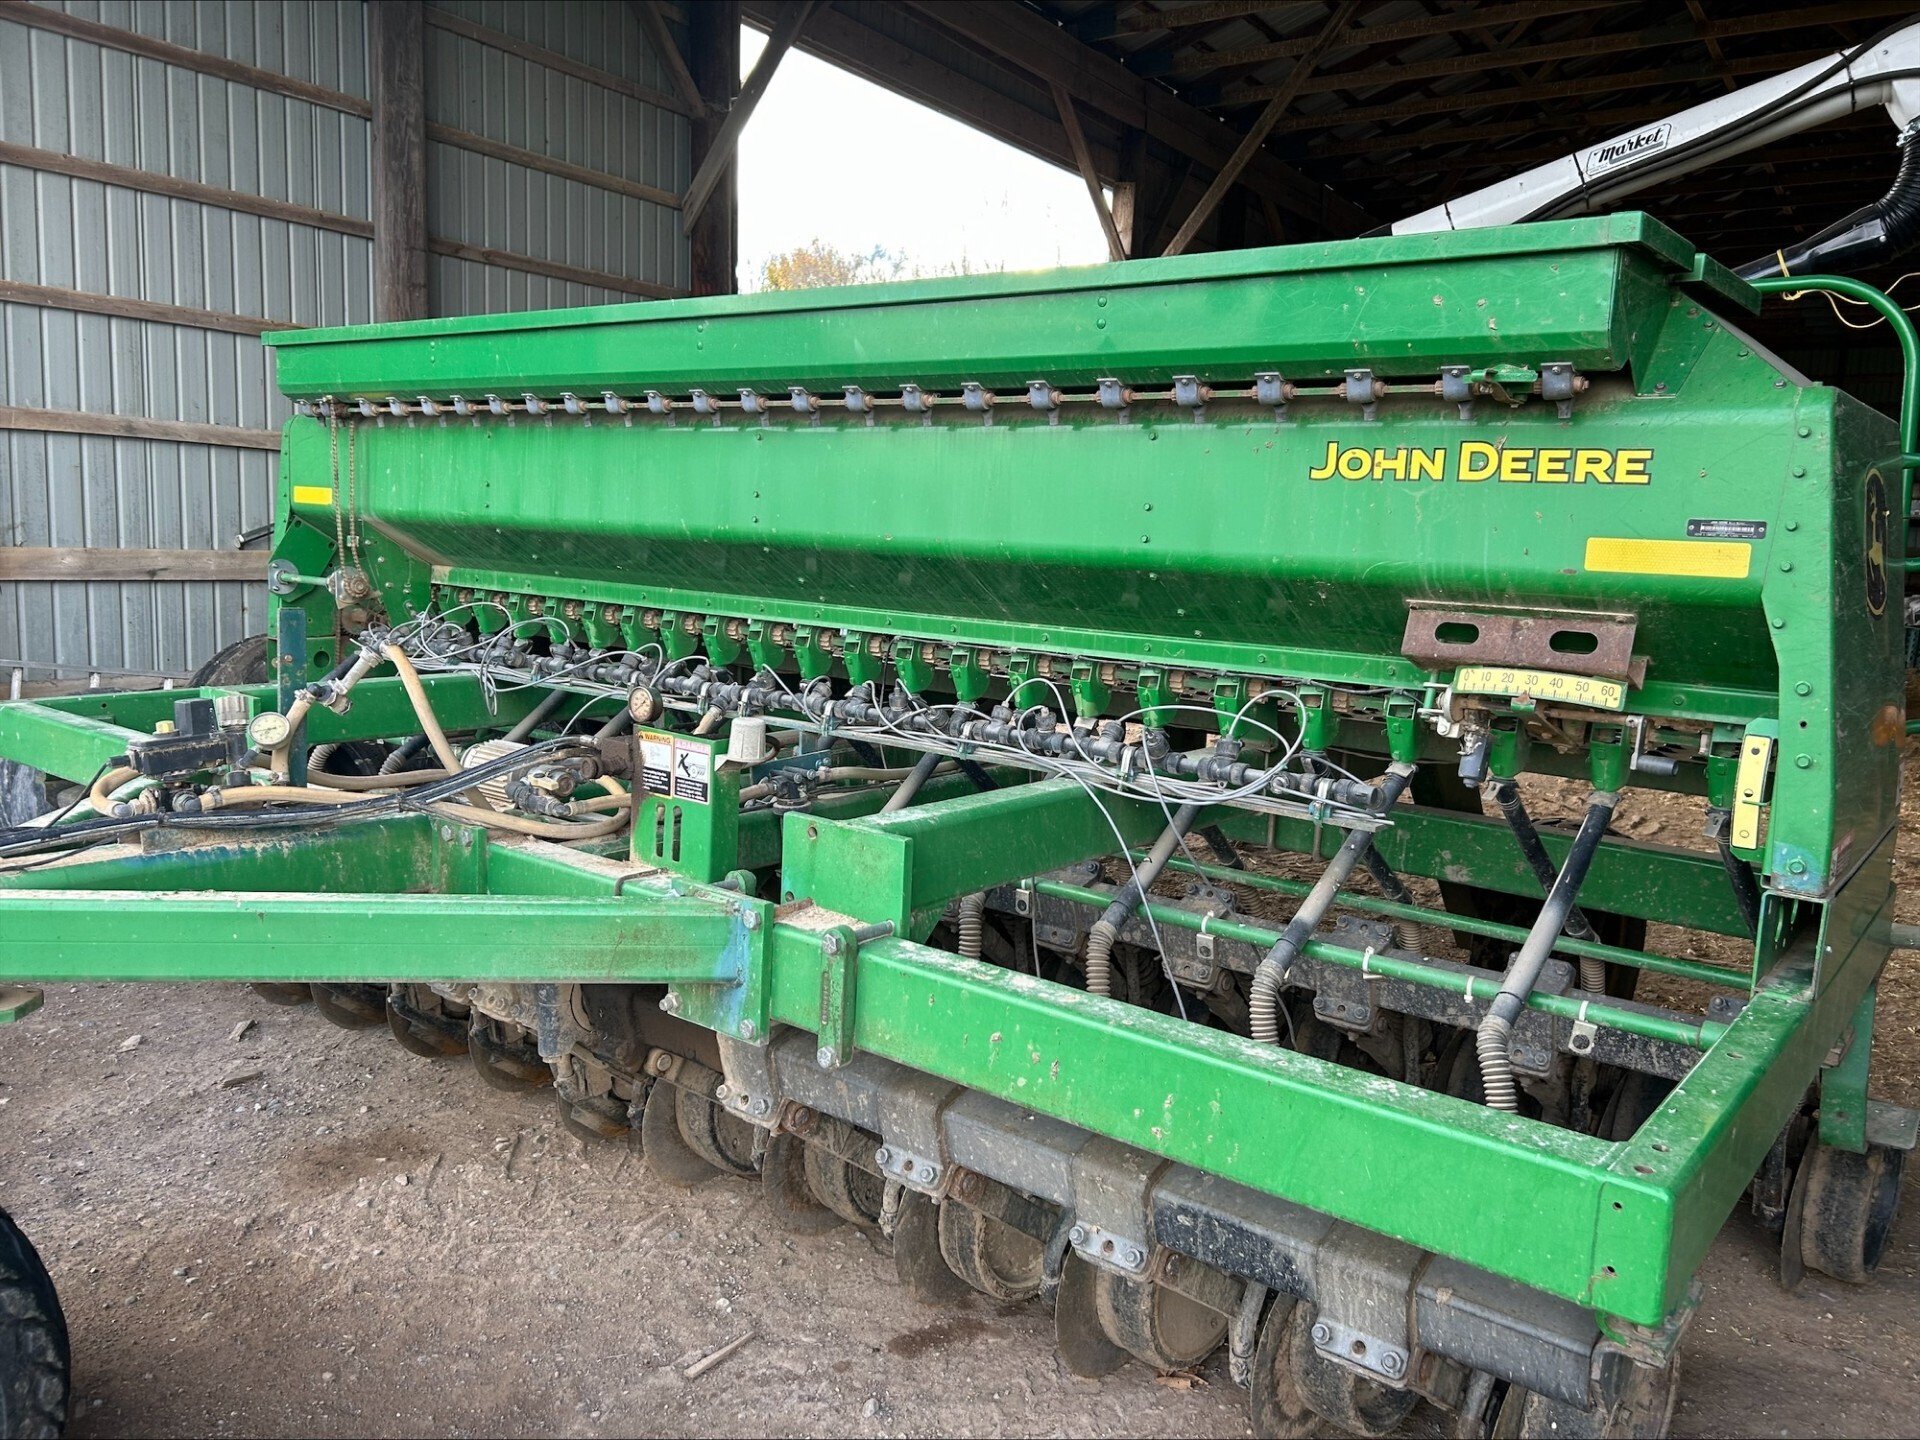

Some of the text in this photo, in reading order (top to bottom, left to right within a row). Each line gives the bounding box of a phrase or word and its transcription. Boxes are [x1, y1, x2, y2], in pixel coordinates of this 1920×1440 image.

[1594, 128, 1664, 163] Market
[1309, 441, 1653, 484] JOHN DEERE
[1481, 671, 1492, 682] 10
[1501, 672, 1515, 683] 20
[1525, 674, 1539, 686] 30
[1549, 677, 1564, 689] 40
[1575, 681, 1590, 693] 50
[1601, 685, 1615, 697] 60
[644, 733, 671, 744] WARNING
